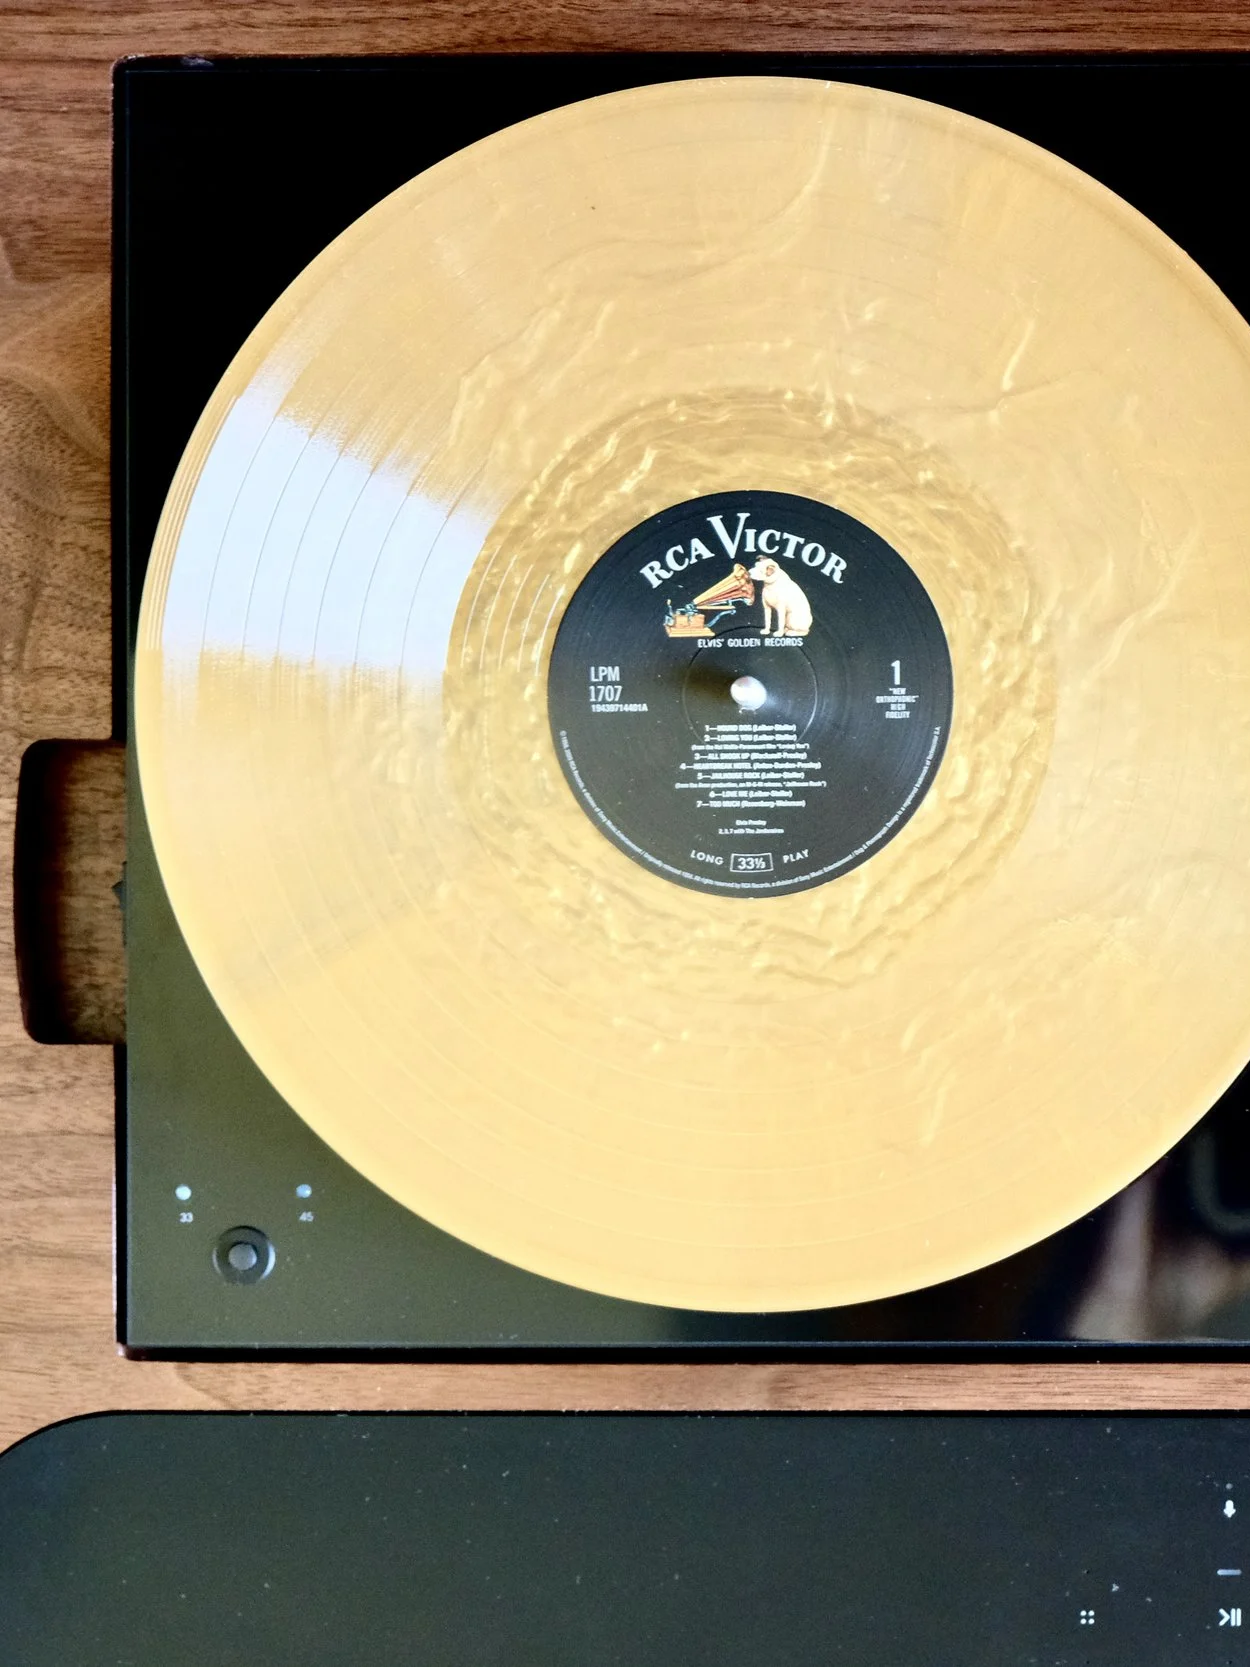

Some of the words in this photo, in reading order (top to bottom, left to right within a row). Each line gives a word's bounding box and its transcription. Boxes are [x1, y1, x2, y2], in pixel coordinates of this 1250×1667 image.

[639, 538, 715, 589] RCA
[728, 638, 760, 647] GOLDEN
[764, 637, 803, 647] RECORDS
[591, 666, 619, 681] LPM
[891, 660, 900, 685] 1
[590, 686, 622, 701] 1707
[691, 850, 723, 865] LONG
[783, 849, 808, 863] PLAY
[179, 1212, 194, 1223] 33
[299, 1211, 314, 1222] 45
